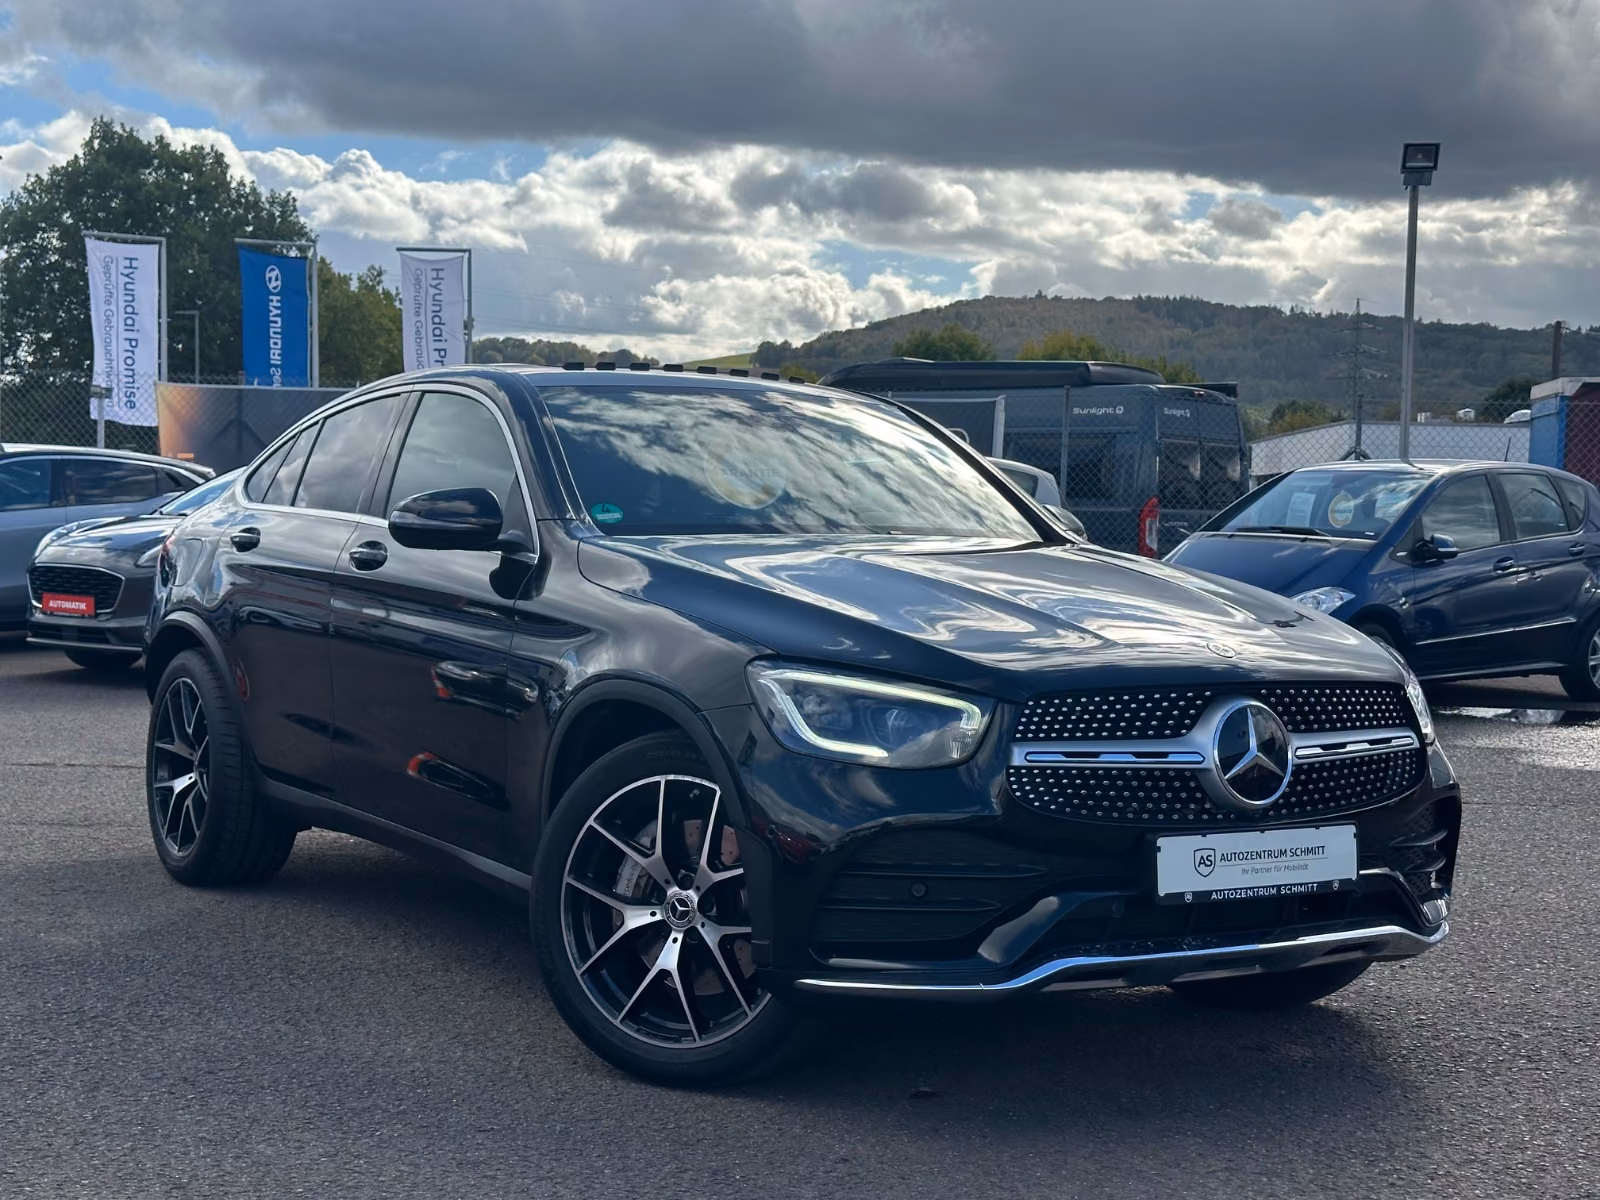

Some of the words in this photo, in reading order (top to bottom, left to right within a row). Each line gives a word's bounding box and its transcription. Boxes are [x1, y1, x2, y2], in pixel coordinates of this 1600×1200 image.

[103, 255, 115, 307] Geprüfte
[120, 256, 140, 333] Hyundai
[413, 267, 424, 318] Geprüfte
[429, 267, 448, 343] Hyundai
[123, 337, 140, 410] Promise
[1072, 406, 1115, 416] Sunlight
[601, 503, 611, 513] 4
[48, 599, 88, 610] AUTOMATIK
[1197, 854, 1213, 869] AS
[1219, 848, 1288, 863] AUTOZENTRUM
[1289, 845, 1326, 858] SCHMITT
[1241, 866, 1250, 876] Ihr
[1251, 864, 1273, 875] Partner
[1273, 863, 1283, 873] für
[1210, 886, 1277, 900] AUTOZENTRUM
[1280, 883, 1318, 895] SCHMITT
